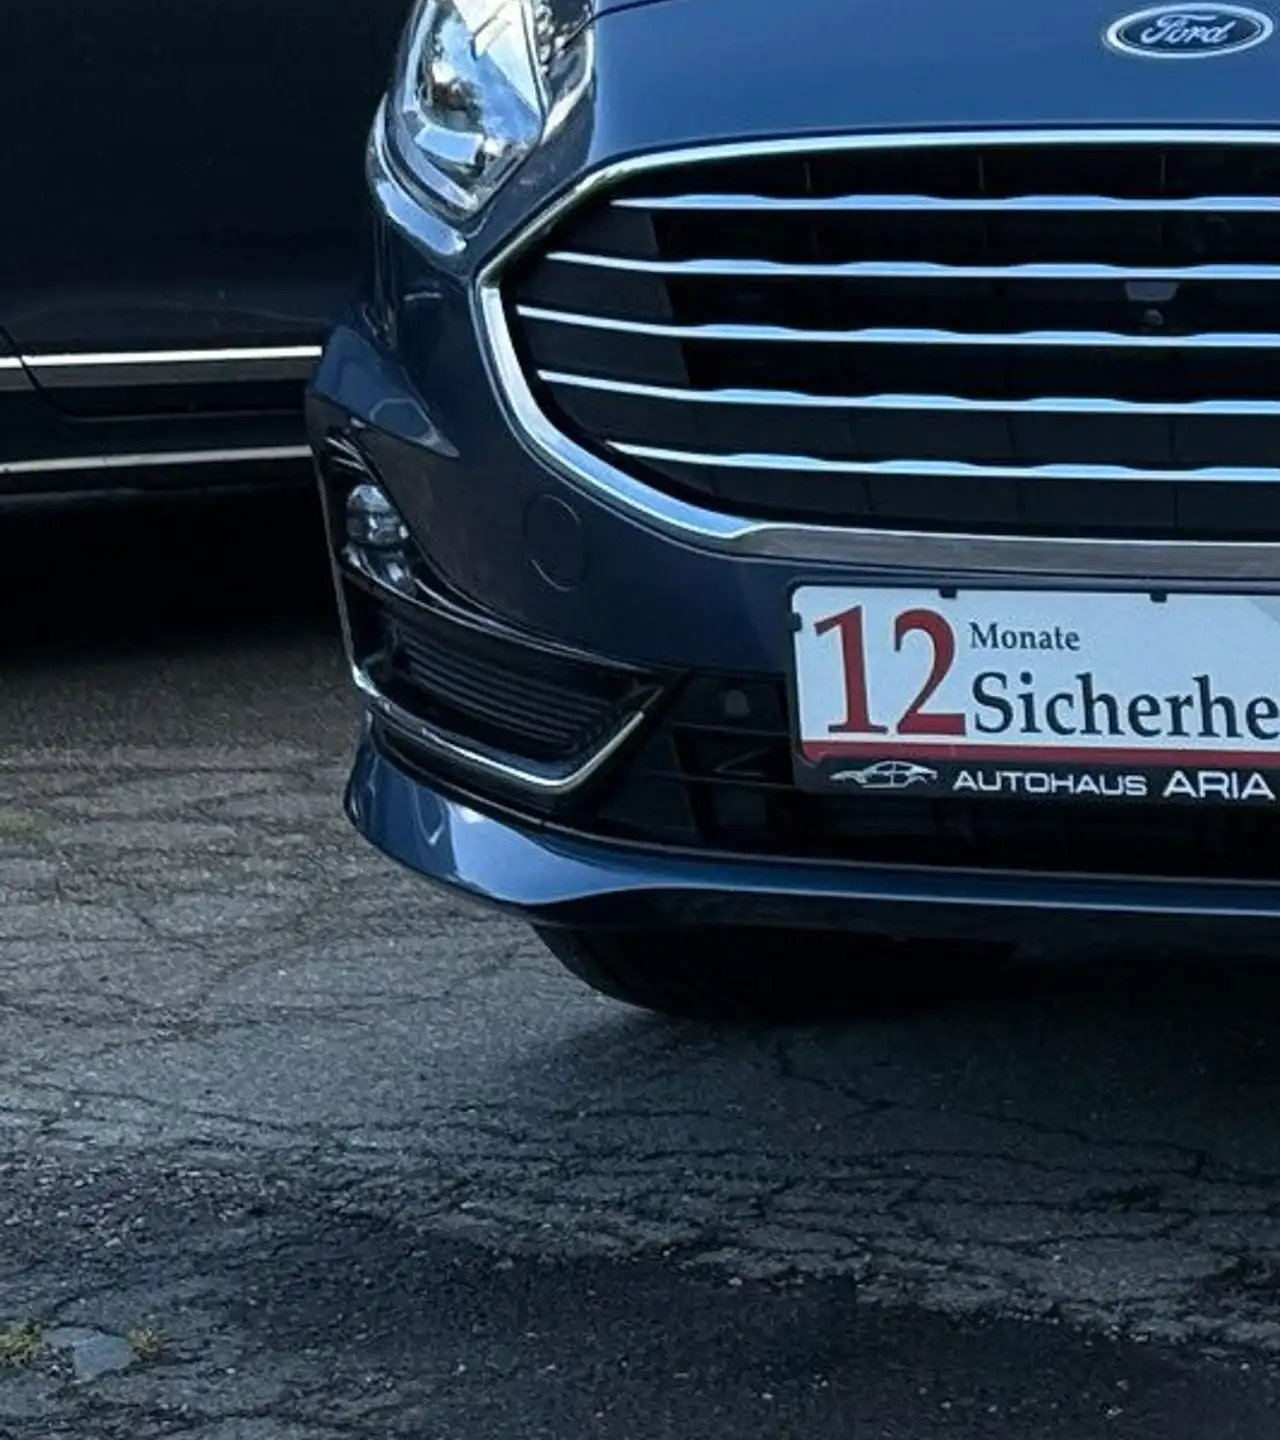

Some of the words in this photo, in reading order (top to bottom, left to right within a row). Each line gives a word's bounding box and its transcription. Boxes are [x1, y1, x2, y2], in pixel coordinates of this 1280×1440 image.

[1140, 13, 1238, 45] Ford
[969, 622, 1080, 651] Monate
[814, 605, 967, 736] 12
[952, 770, 1148, 796] AUTOHAUS
[1163, 770, 1276, 800] ARIA
